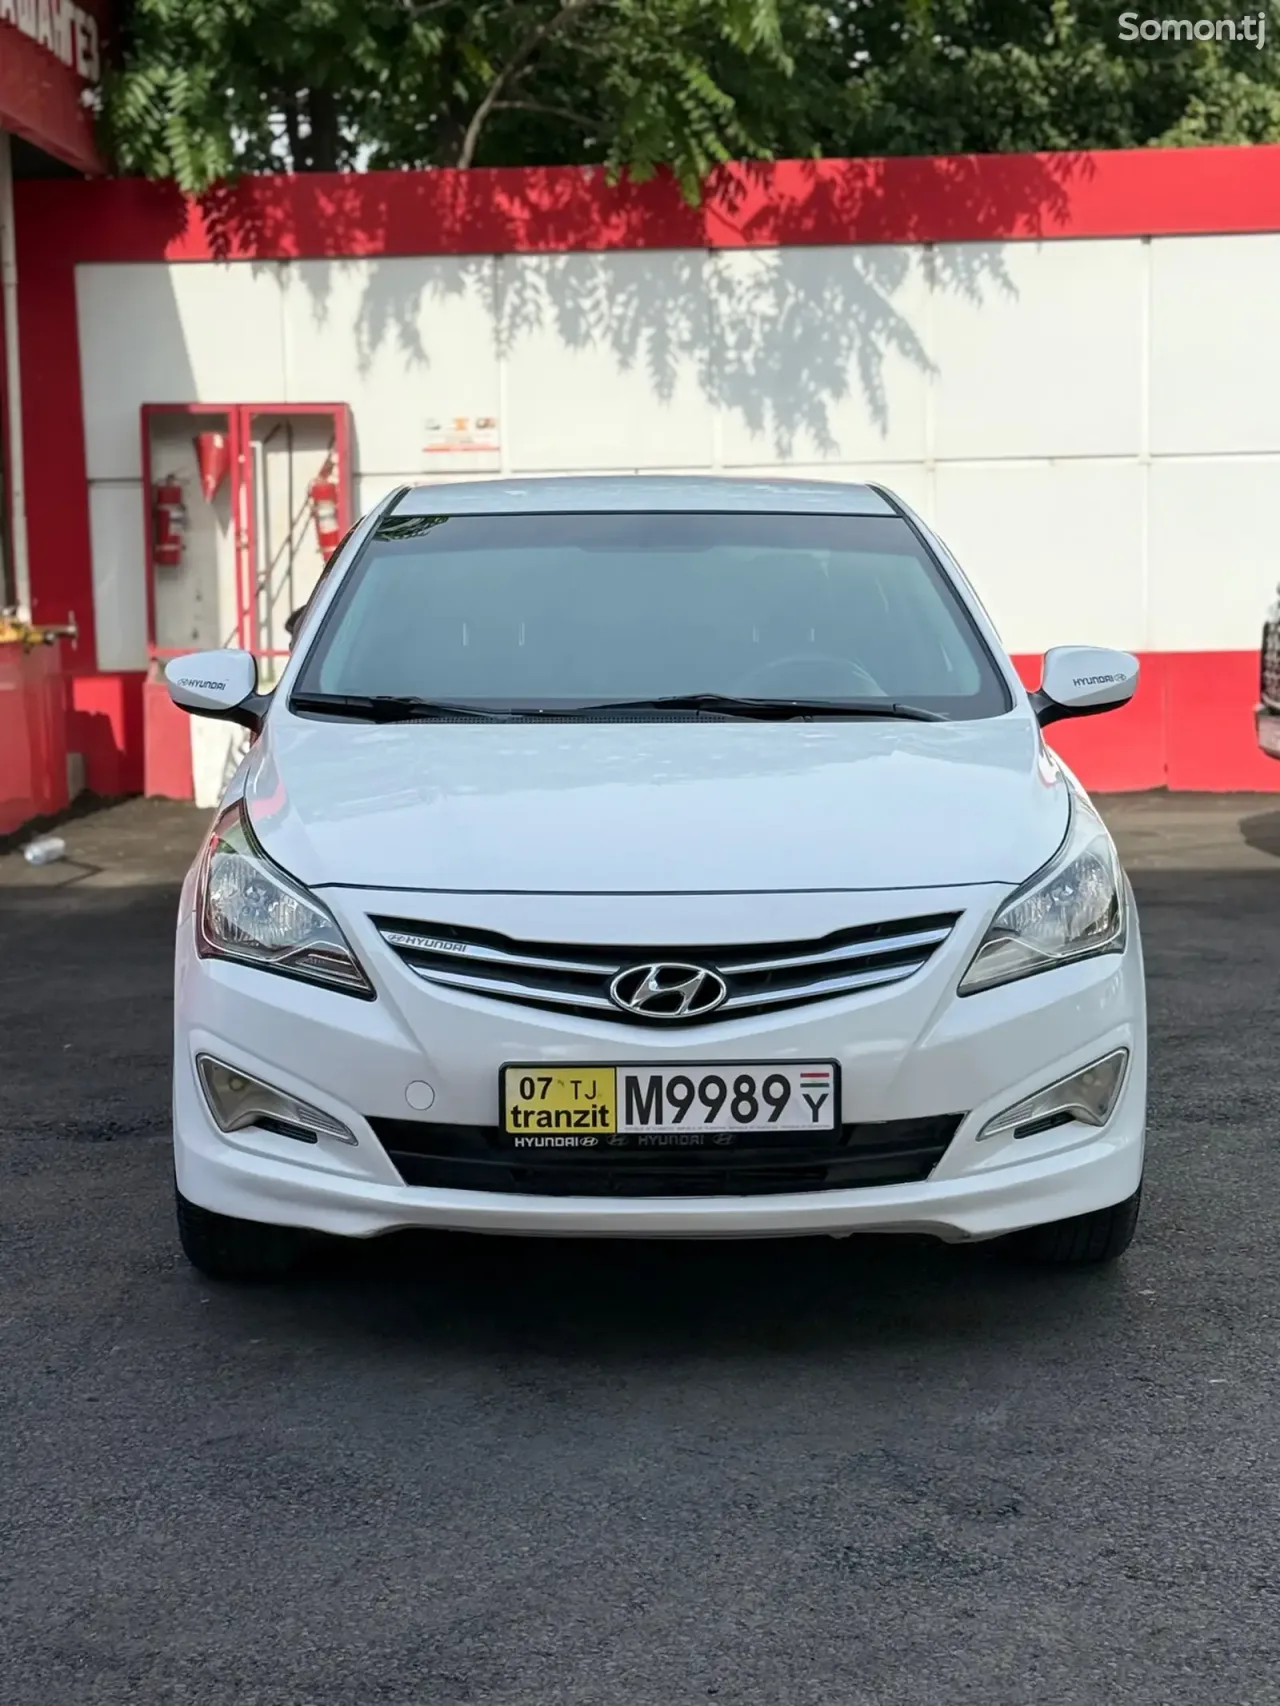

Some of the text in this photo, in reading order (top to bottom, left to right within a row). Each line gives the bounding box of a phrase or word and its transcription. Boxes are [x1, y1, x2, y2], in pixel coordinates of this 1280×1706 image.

[188, 679, 226, 690] HYUNDAI
[1072, 675, 1114, 686] HYUNDAI
[405, 936, 466, 952] HYUNDAI
[519, 1077, 596, 1100] 07 TJ
[625, 1073, 829, 1126] M9989 Y
[511, 1104, 609, 1128] tranzit
[514, 1137, 579, 1147] HYUNDAI
[638, 1134, 704, 1146] HYUNDAI
